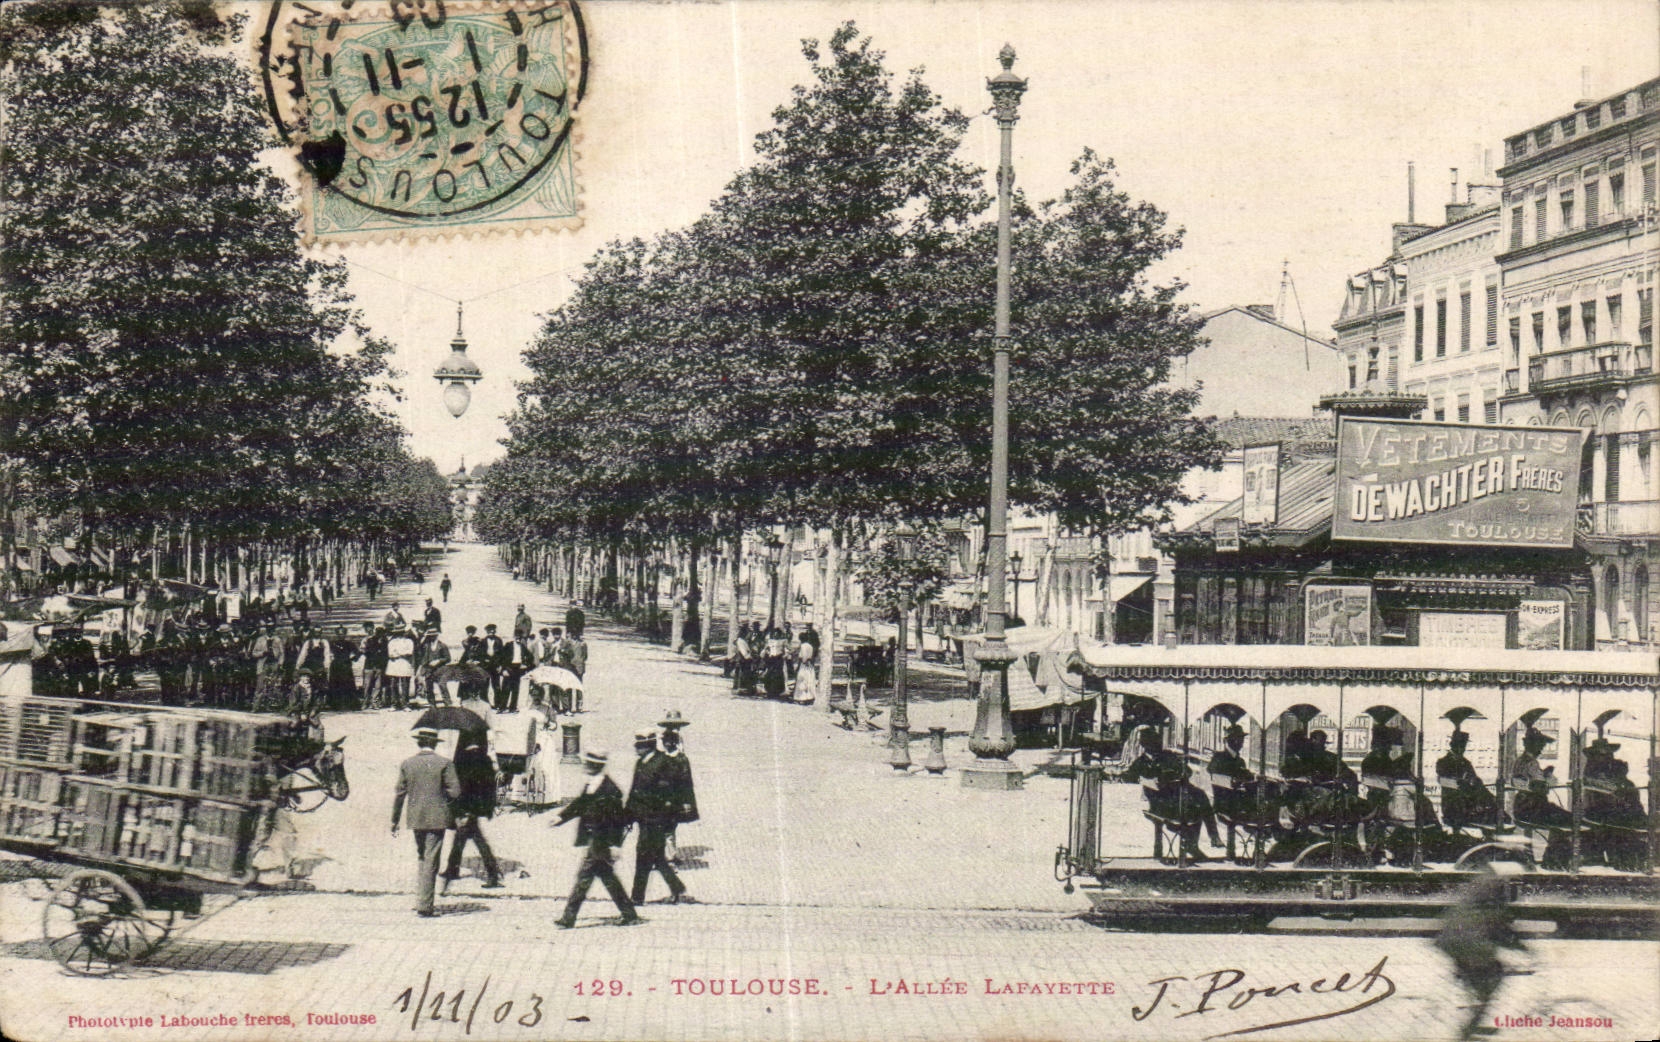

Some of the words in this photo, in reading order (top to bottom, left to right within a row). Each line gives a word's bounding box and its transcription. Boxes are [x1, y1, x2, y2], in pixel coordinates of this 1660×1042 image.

[350, 88, 567, 203] TOULOUS
[1350, 456, 1504, 522] DEWACHTER
[1448, 520, 1564, 542] TOULOUSE
